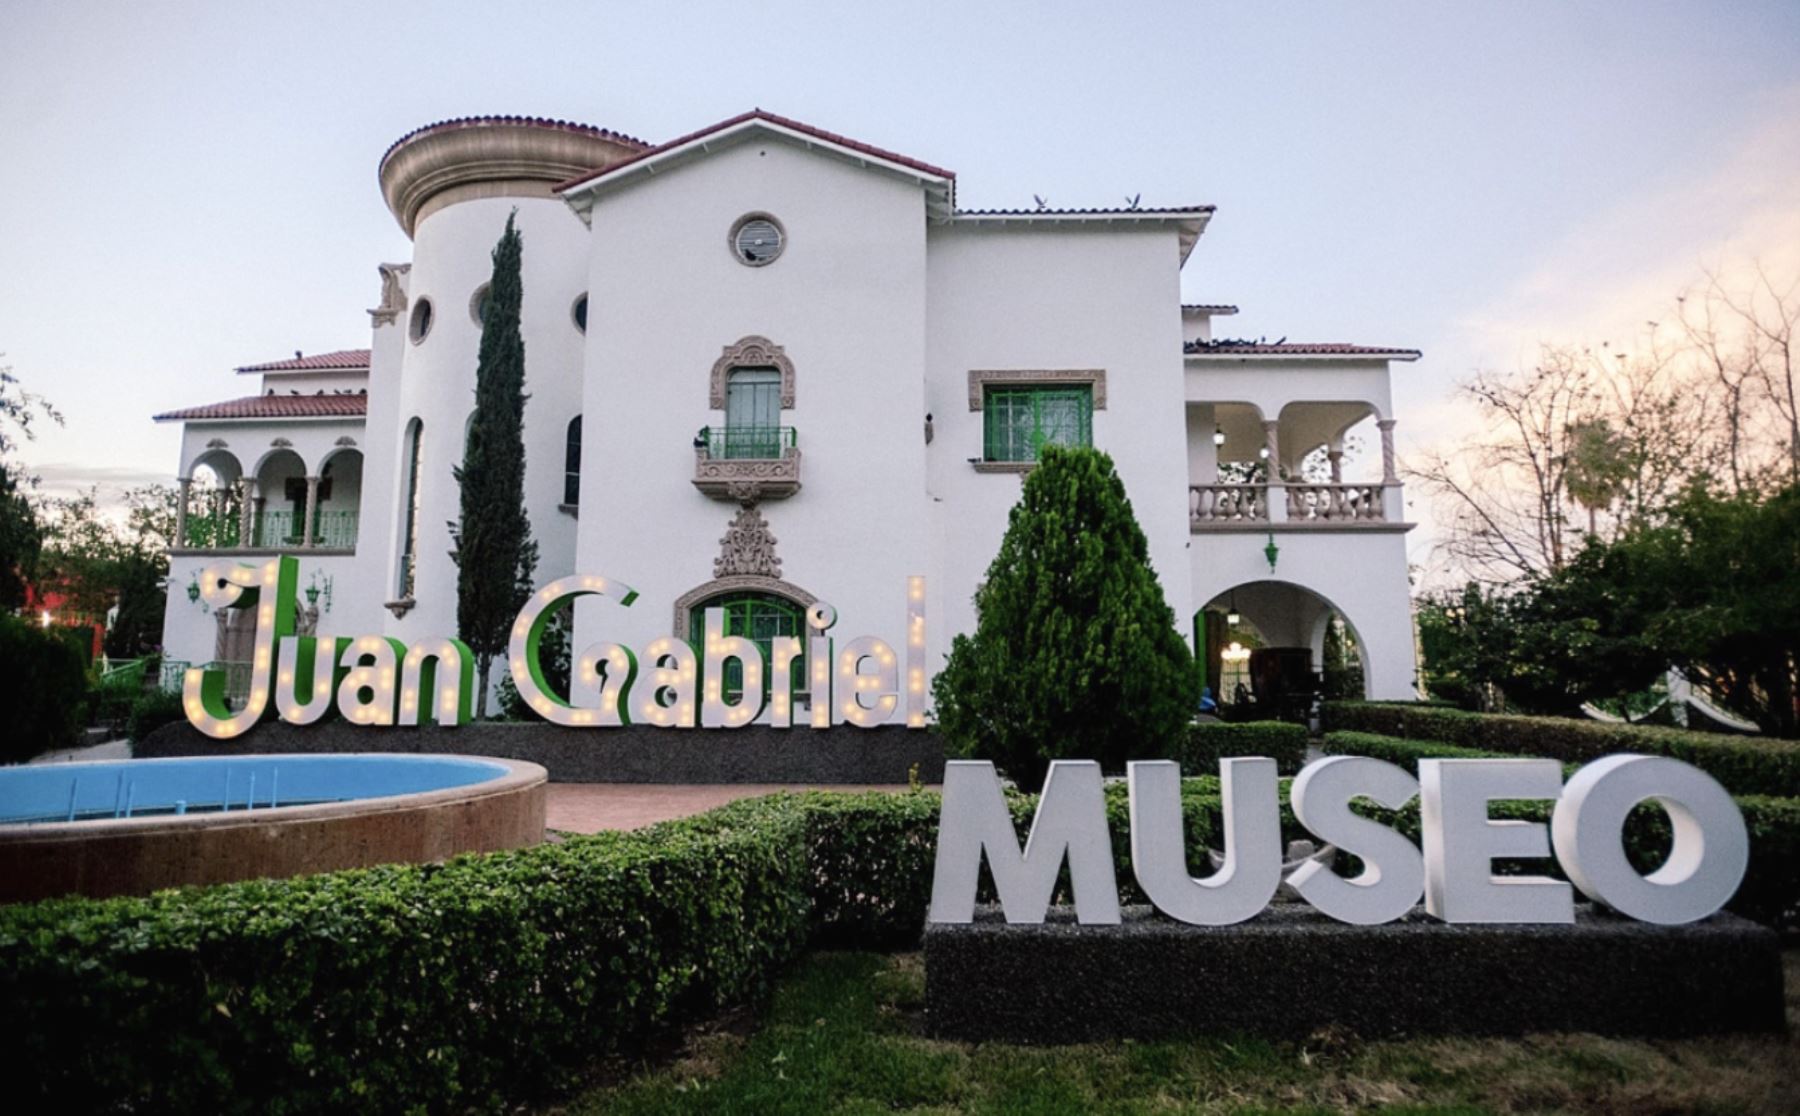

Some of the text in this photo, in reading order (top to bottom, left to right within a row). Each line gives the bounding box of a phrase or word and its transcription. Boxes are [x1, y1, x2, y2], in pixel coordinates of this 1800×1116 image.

[182, 556, 926, 739] Juan Gabriel
[929, 753, 1749, 925] MUSEO
